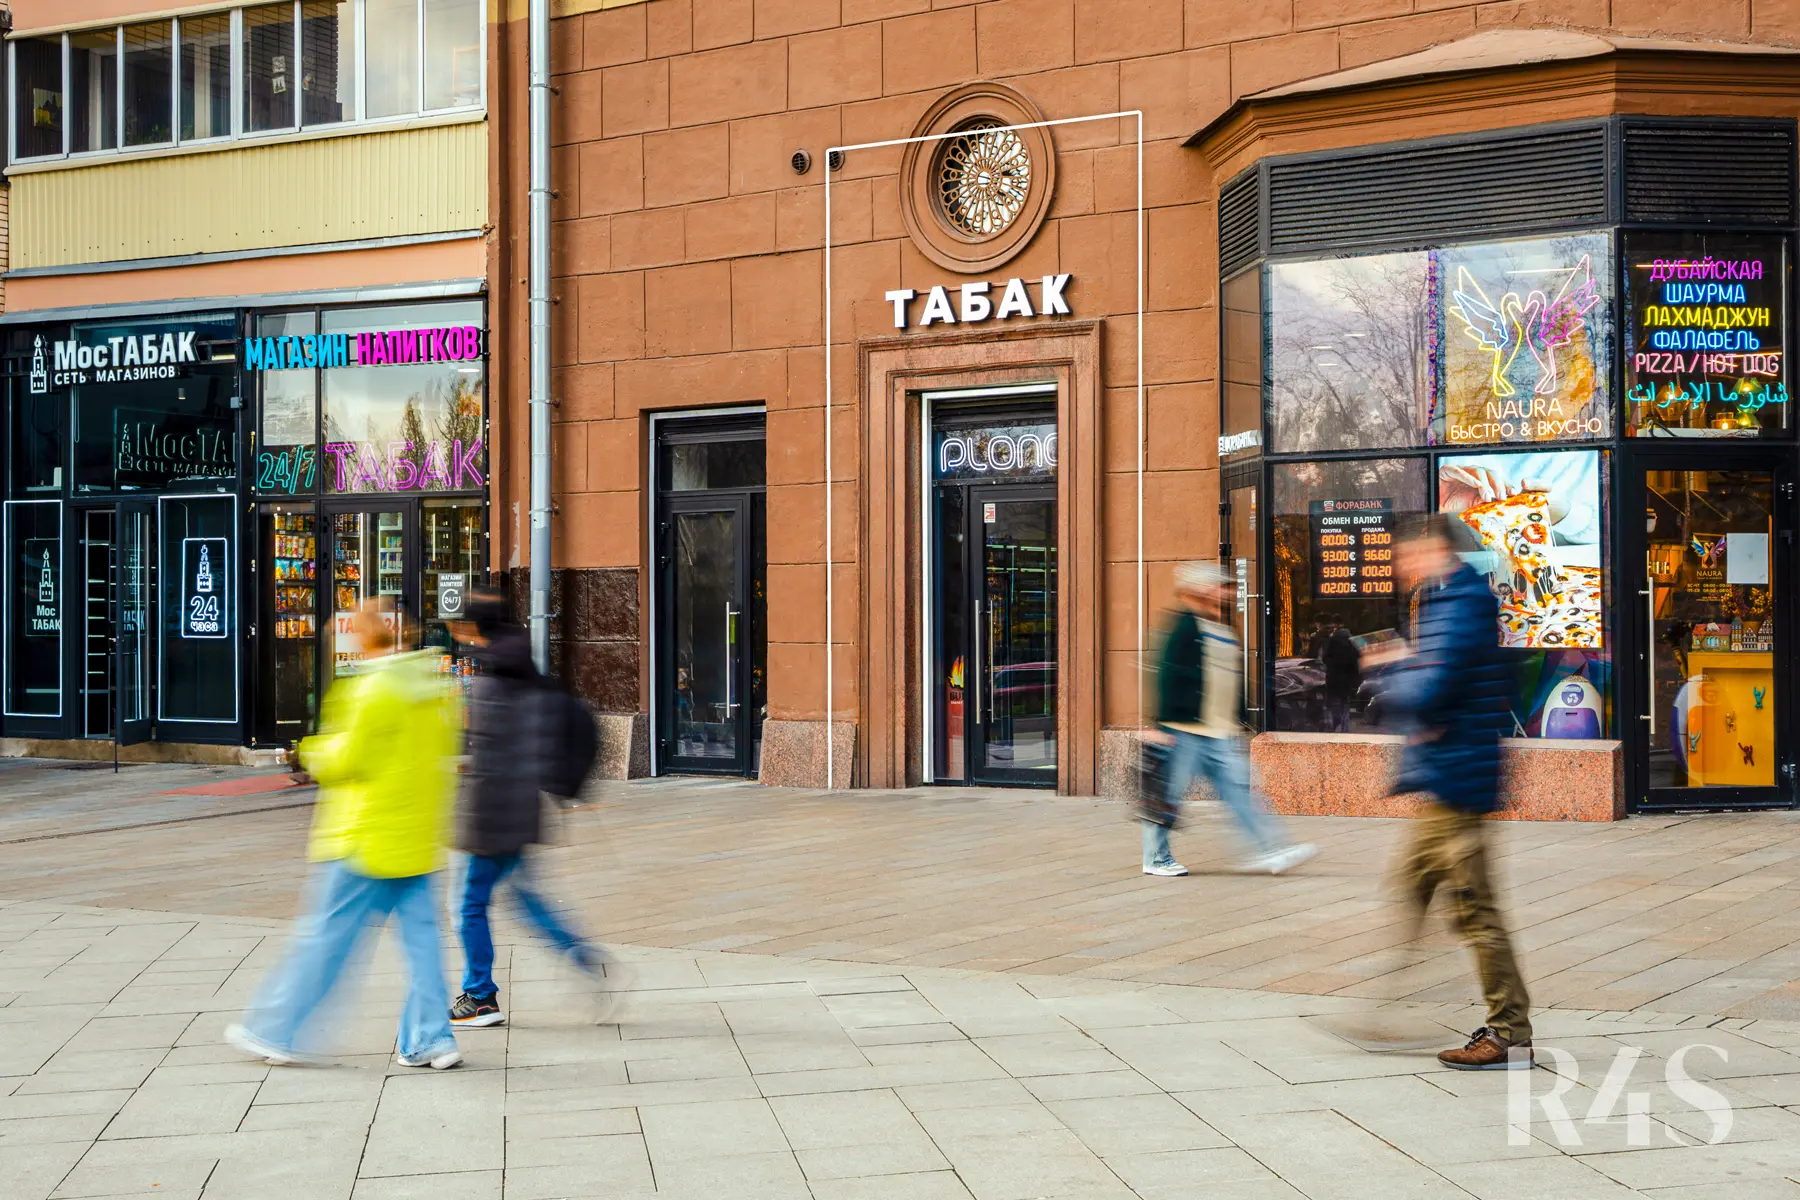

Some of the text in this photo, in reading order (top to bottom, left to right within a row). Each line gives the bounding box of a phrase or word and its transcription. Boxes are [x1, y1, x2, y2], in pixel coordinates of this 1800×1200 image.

[1650, 256, 1763, 282] ДУБАЙСКАЯ
[885, 274, 1072, 328] ТАБАК
[1666, 283, 1746, 303] ШАУРМА
[1644, 306, 1770, 329] ЛАХМАДЖУН
[246, 326, 479, 370] МАГАЗИН НАПИТКОВ
[1654, 330, 1760, 350] ФАЛАФЕЛЬ
[54, 331, 197, 370] МосТАБАК
[1635, 353, 1685, 373] PIZZA
[1703, 354, 1734, 373] HOT
[1743, 354, 1779, 373] DOG
[54, 365, 176, 385] СЕТЬ МАГАЗИНОВ
[1486, 398, 1563, 420] NAURA
[1451, 417, 1602, 440] БЫСТРО & ВКУСНО
[259, 445, 316, 494] 24/7
[324, 439, 483, 491] ТАБАК
[1336, 501, 1382, 510] ФОРАБАНК
[1322, 516, 1382, 525] ОБМЕН ВАЛЮТ
[1321, 535, 1349, 545] 80.00
[1363, 534, 1391, 544] 83.00
[1322, 551, 1349, 561] 93.00
[1364, 550, 1391, 560] 96.60
[1323, 567, 1349, 577] 93.00
[1362, 566, 1391, 576] 100.20
[1363, 582, 1392, 592] 107.00
[190, 595, 219, 621] 24
[444, 596, 459, 604] 24/7
[36, 605, 56, 616] Мос
[32, 619, 61, 630] ТАБАК
[190, 621, 218, 632] часа
